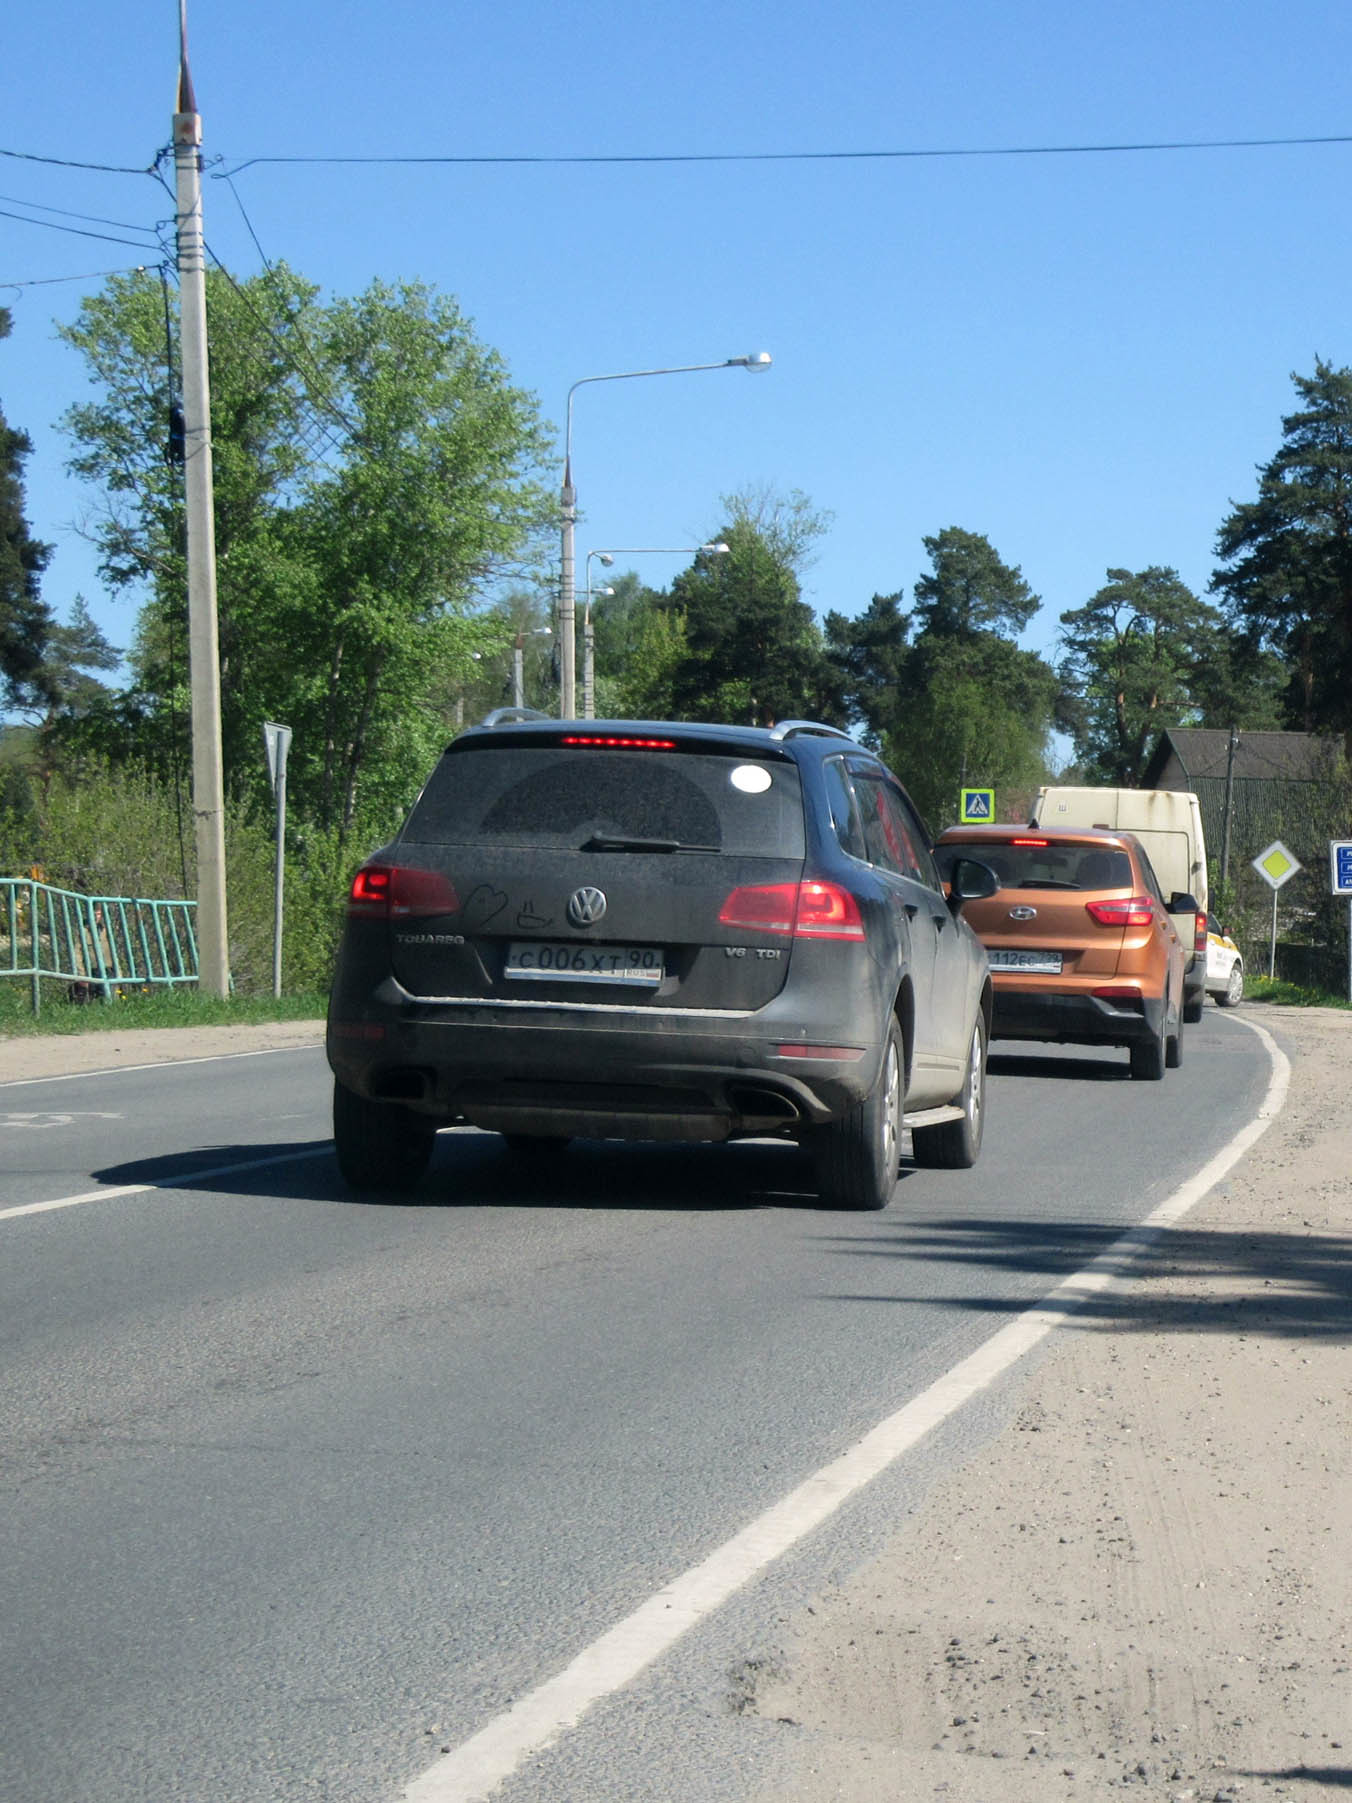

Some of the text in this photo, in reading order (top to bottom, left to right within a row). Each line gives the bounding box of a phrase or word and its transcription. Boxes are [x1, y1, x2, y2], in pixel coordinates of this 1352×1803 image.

[396, 933, 465, 945] TOUAREG
[725, 946, 781, 960] V6 TDI
